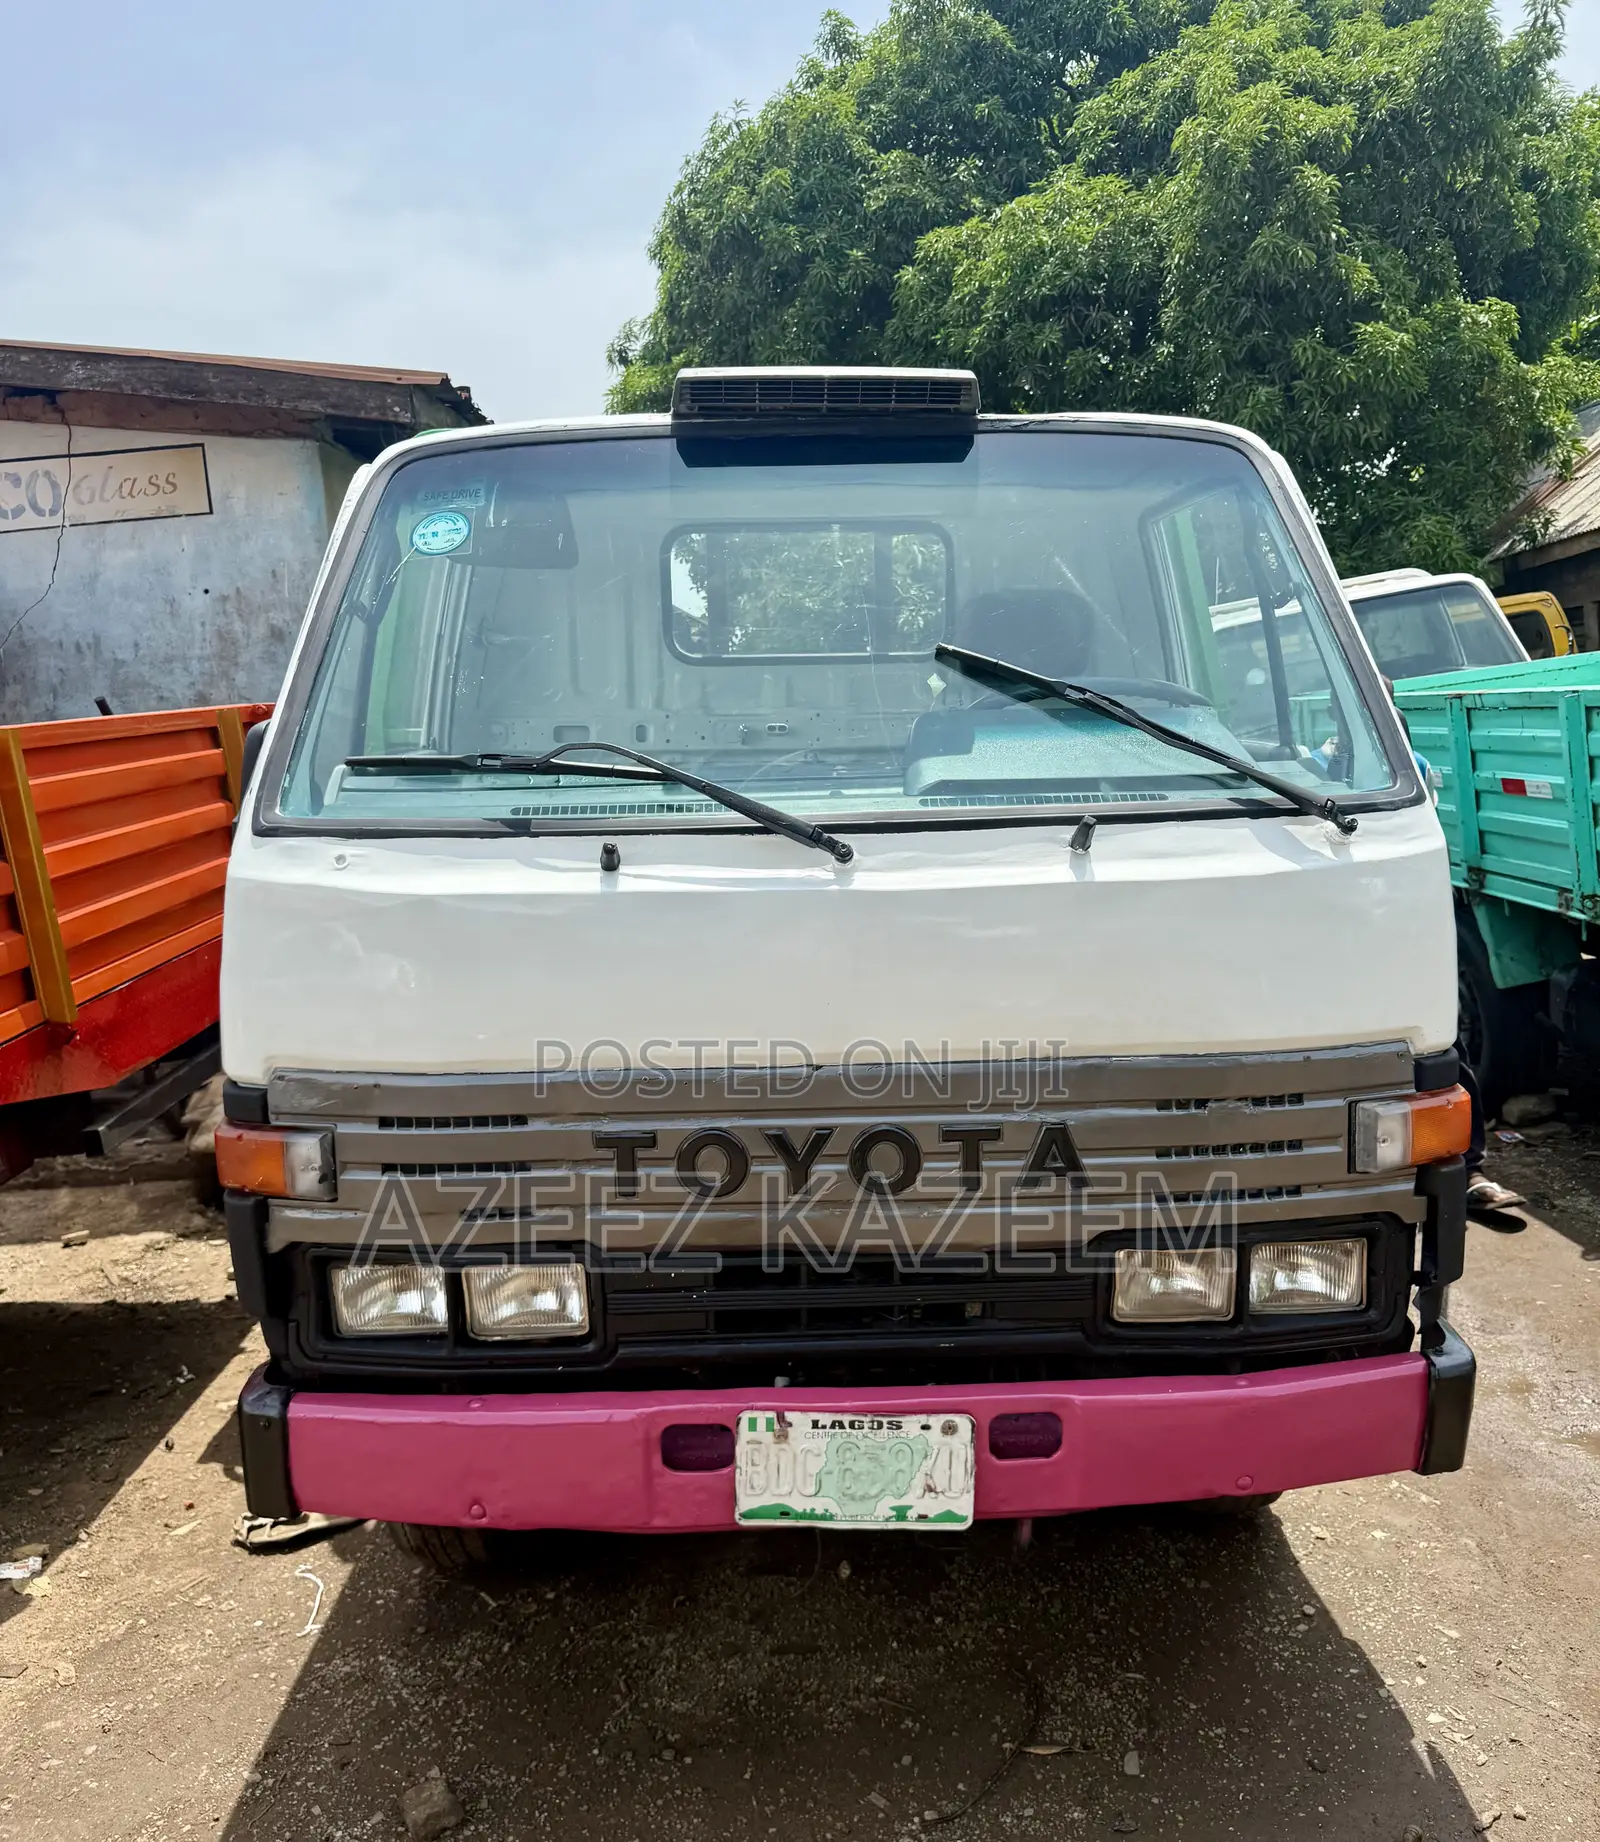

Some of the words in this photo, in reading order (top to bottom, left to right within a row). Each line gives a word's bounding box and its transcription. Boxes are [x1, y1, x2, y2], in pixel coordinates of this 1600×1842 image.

[424, 490, 449, 501] SAFE
[451, 488, 482, 500] DRIVE
[593, 1122, 1093, 1199] TOYOTA
[811, 1419, 904, 1430] LAGOS
[804, 1431, 840, 1440] CENTRE
[840, 1431, 853, 1439] OF
